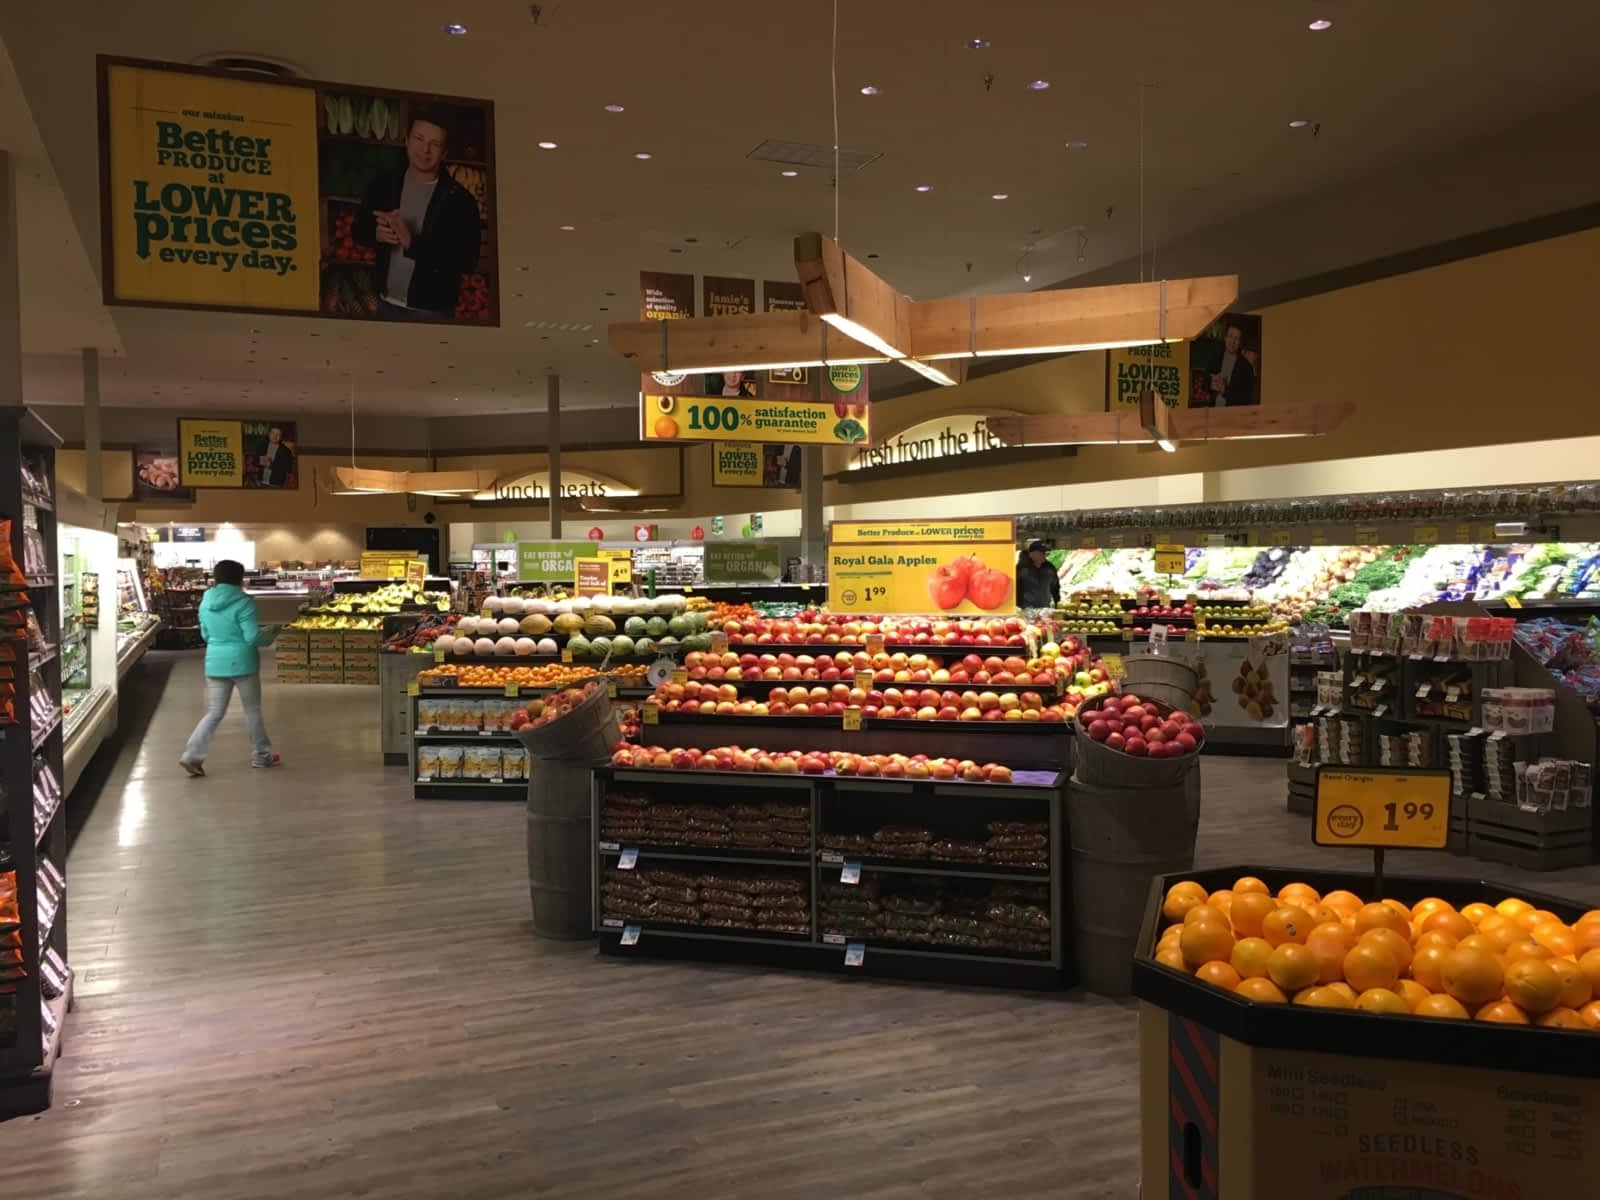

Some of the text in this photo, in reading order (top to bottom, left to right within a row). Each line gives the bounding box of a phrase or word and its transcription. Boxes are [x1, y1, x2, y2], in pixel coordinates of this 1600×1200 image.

[182, 109, 245, 122] our mission
[156, 121, 272, 158] Better
[157, 150, 272, 175] PRODUCE
[208, 172, 225, 184] at
[134, 180, 296, 223] LOWER
[134, 212, 297, 260] prices
[160, 247, 297, 276] every day.
[711, 303, 750, 316] TIPS
[1118, 362, 1181, 381] LOWER
[688, 405, 753, 431] 100%
[755, 406, 826, 419] satisfaction
[755, 417, 817, 429] guarantee
[859, 420, 1000, 469] fresh from the fie
[188, 451, 234, 461] LOWER
[720, 451, 757, 461] LOWER
[188, 460, 235, 474] prices
[719, 460, 757, 473] prices
[494, 480, 543, 499] lunch
[857, 529, 881, 537] Better
[882, 528, 914, 537] Produce
[921, 528, 952, 536] LOWER
[953, 525, 985, 538] prices
[542, 559, 574, 572] ORGA
[834, 554, 937, 568] Royal Gala Apples
[1358, 1134, 1480, 1166] SEEDLESS
[1319, 1157, 1522, 1200] WATERMELONS
